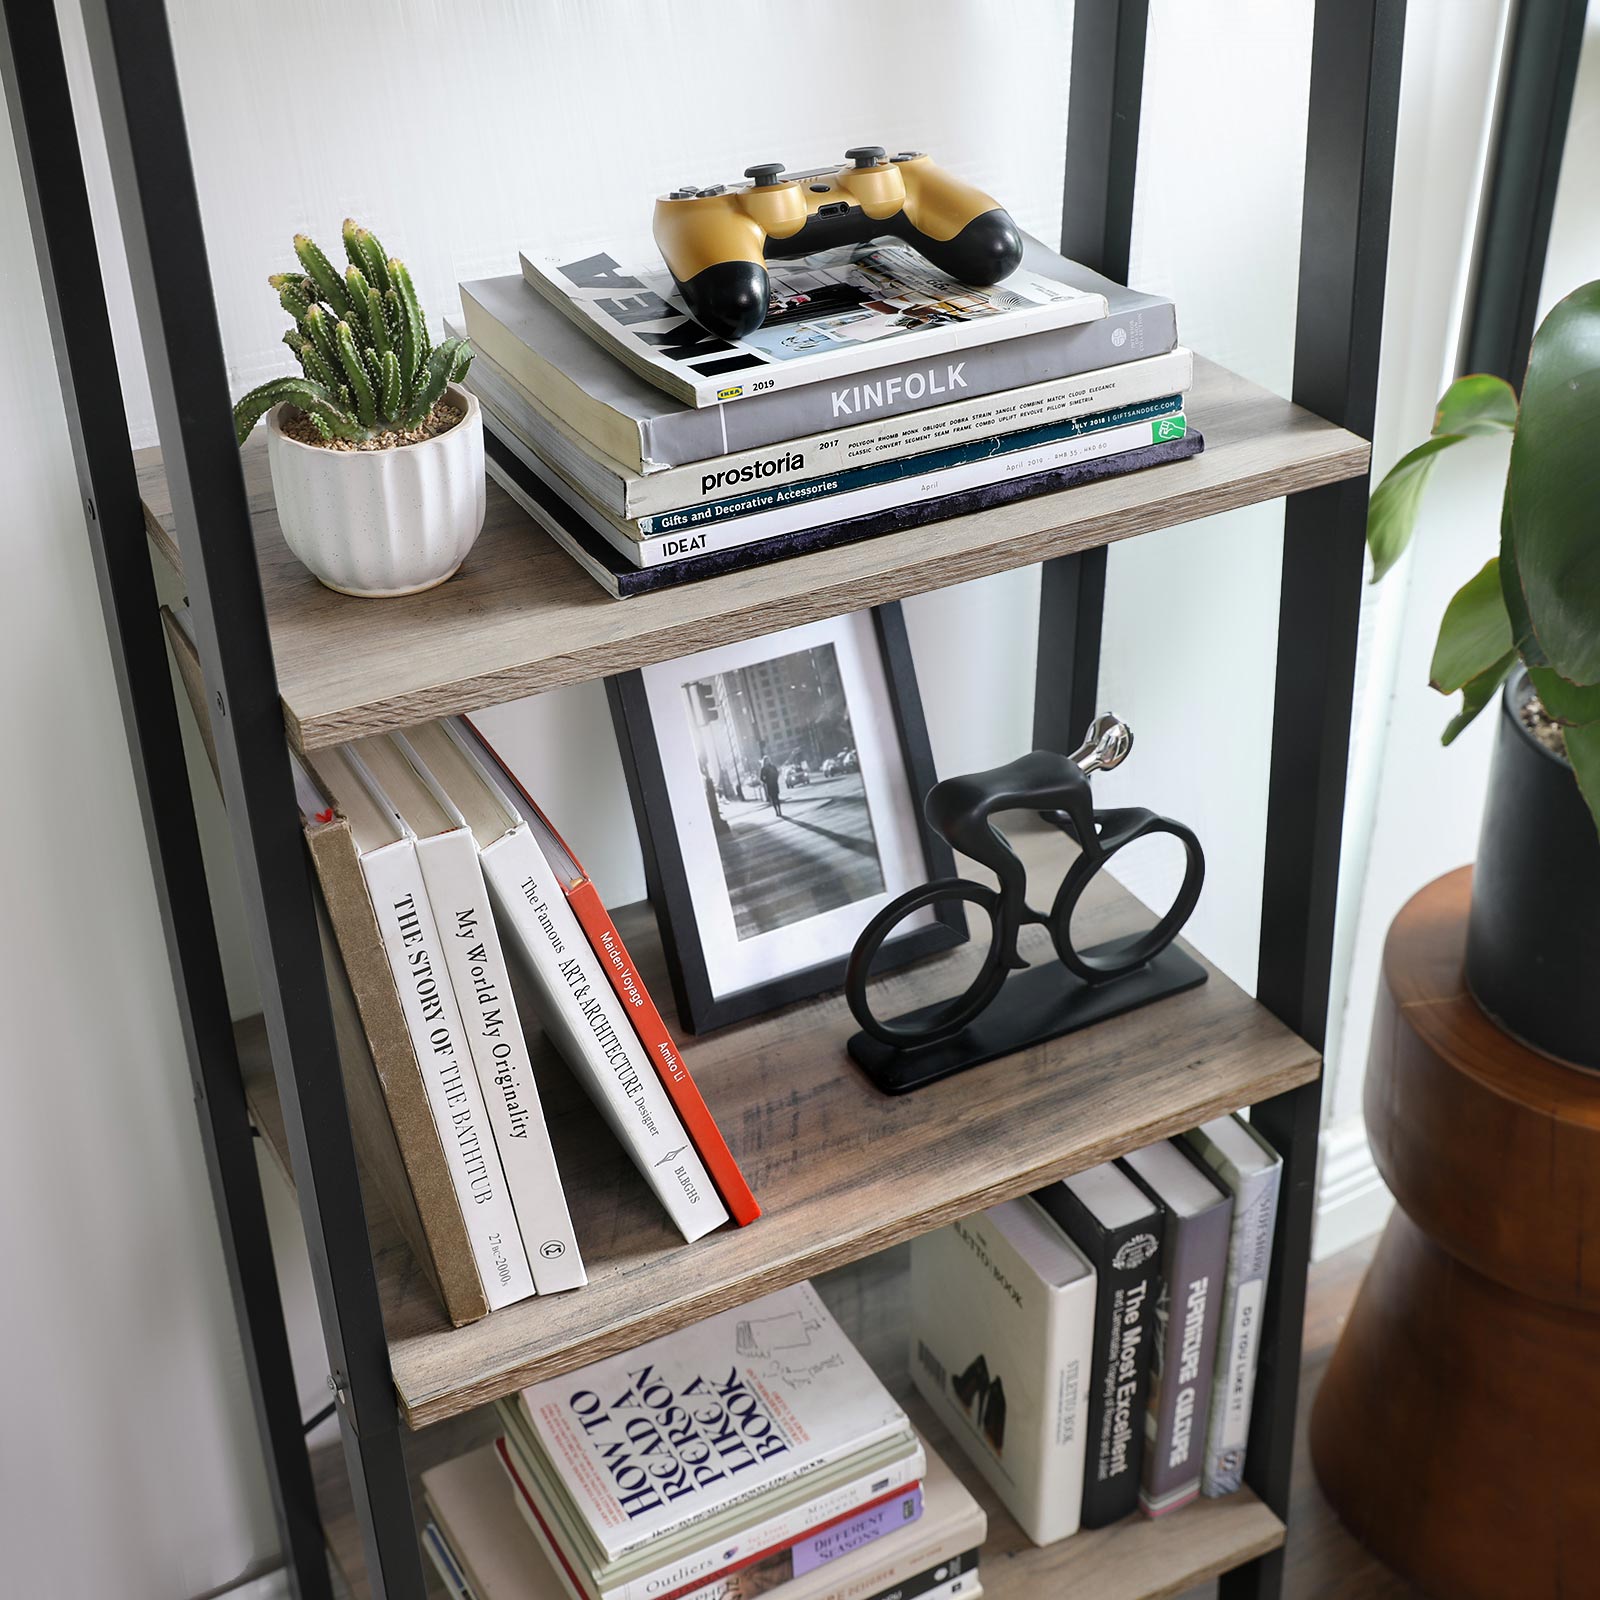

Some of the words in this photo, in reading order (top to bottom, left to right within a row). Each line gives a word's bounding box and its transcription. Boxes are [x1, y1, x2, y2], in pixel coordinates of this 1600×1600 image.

[718, 386, 742, 399] IKEA
[752, 379, 775, 392] 2019
[831, 361, 968, 417] KINFOLK
[847, 447, 872, 458] CLASSIC
[875, 441, 901, 452] CONVERT
[905, 434, 931, 445] SEGMENT
[934, 429, 950, 438] SEAM
[953, 424, 972, 433] FRAME
[975, 419, 995, 429] COMBO
[999, 414, 1017, 423] UPLIFT
[1020, 408, 1043, 418] REVOLVE
[1046, 403, 1066, 412] PILLOW
[1069, 396, 1094, 407] SIMETRIA
[848, 438, 875, 449] POLYGON
[878, 432, 899, 443] RHOMB
[902, 428, 919, 436] MONK
[922, 421, 946, 432] OBLIQUE
[950, 416, 969, 426] DOBRA
[972, 411, 992, 421] STRAIN
[1020, 399, 1044, 410] COMBINE
[1047, 395, 1066, 403] MATCH
[1068, 389, 1086, 399] CLOUD
[1089, 383, 1116, 393] ELEGANCE
[1071, 421, 1088, 431] JULY
[1090, 417, 1105, 427] 2018
[1112, 401, 1175, 422] GIFTSANDDEC.COM
[819, 439, 840, 451] 2017
[1006, 462, 1024, 472] April
[1028, 457, 1043, 467] 2019
[701, 452, 805, 495] prostoria
[921, 481, 938, 492] April
[661, 515, 688, 528] Gifts
[691, 508, 712, 521] and
[714, 496, 774, 515] Decorative
[776, 480, 838, 501] Accessories
[662, 534, 707, 557] IDEAT
[520, 876, 539, 905] The
[394, 893, 424, 948] THE
[455, 908, 478, 939] My
[534, 902, 566, 954] Famous
[408, 950, 445, 1023] STORY
[466, 942, 498, 1004] World
[558, 958, 588, 988] ART
[600, 931, 624, 971] Maiden
[620, 967, 644, 1008] Voyage
[573, 984, 591, 998] &
[429, 1027, 454, 1056] OF
[482, 1008, 504, 1038] My
[579, 997, 644, 1099] ARCHITECTURE
[657, 1041, 678, 1073] Amiko
[673, 1074, 686, 1083] Li
[439, 1060, 467, 1108] THE
[492, 1043, 529, 1139] Originality
[634, 1095, 660, 1137] Designer
[452, 1109, 493, 1205] BATHTUB
[674, 1166, 700, 1204] BLBGHS
[1113, 1289, 1124, 1308] and
[1124, 1280, 1147, 1325] The
[1243, 1306, 1253, 1327] DO
[1118, 1326, 1143, 1382] Most
[1238, 1331, 1250, 1360] YOU
[680, 1376, 713, 1396] A
[1235, 1362, 1247, 1393] LIKE
[569, 1390, 612, 1435] TO
[610, 1389, 644, 1409] A
[711, 1366, 792, 1462] BOOK
[627, 1364, 730, 1490] PERSON
[693, 1402, 760, 1476] LIKE
[1109, 1381, 1137, 1478] Excellent
[594, 1441, 666, 1519] HOW
[625, 1417, 698, 1503] READ
[815, 1512, 884, 1552] DIFFERENT
[819, 1530, 879, 1558] SEASONS
[645, 1558, 713, 1594] Outliers
